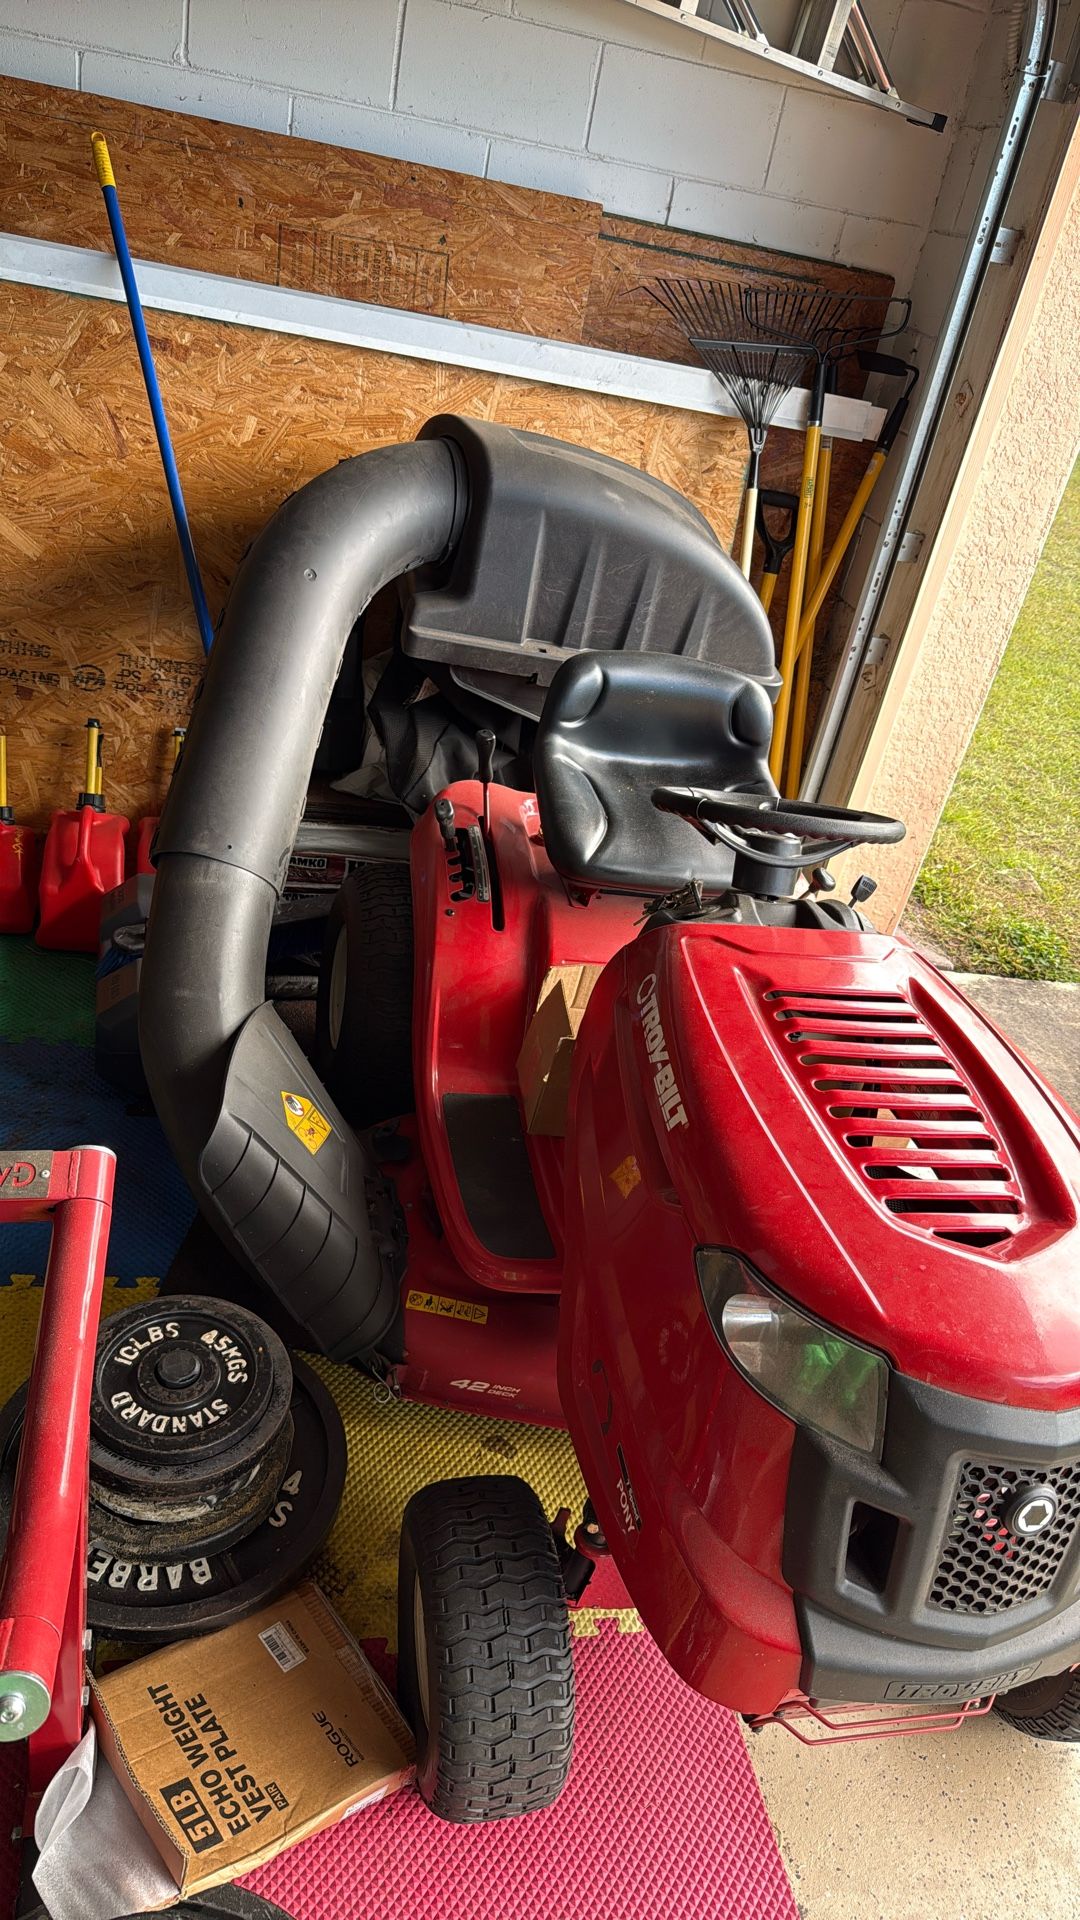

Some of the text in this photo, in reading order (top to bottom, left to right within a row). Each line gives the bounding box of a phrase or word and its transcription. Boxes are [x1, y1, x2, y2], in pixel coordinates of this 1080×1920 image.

[117, 653, 203, 675] THICKNES
[289, 857, 326, 868] AMKO
[640, 992, 688, 1132] TROY-BILT
[201, 1329, 248, 1384] 4.5KGS
[450, 1379, 490, 1393] 42
[487, 1389, 518, 1398] DECK
[492, 1384, 521, 1393] INCH
[111, 1391, 229, 1434] STANDARD
[616, 1478, 635, 1532] PONY
[87, 1548, 213, 1592] BARBE
[147, 1683, 251, 1836] ECHO WEIGHT
[184, 1693, 272, 1823] VEST PLATE
[311, 1710, 358, 1767] ROGUE
[171, 1789, 215, 1842] 5LB
[266, 1785, 287, 1809] PAIR
